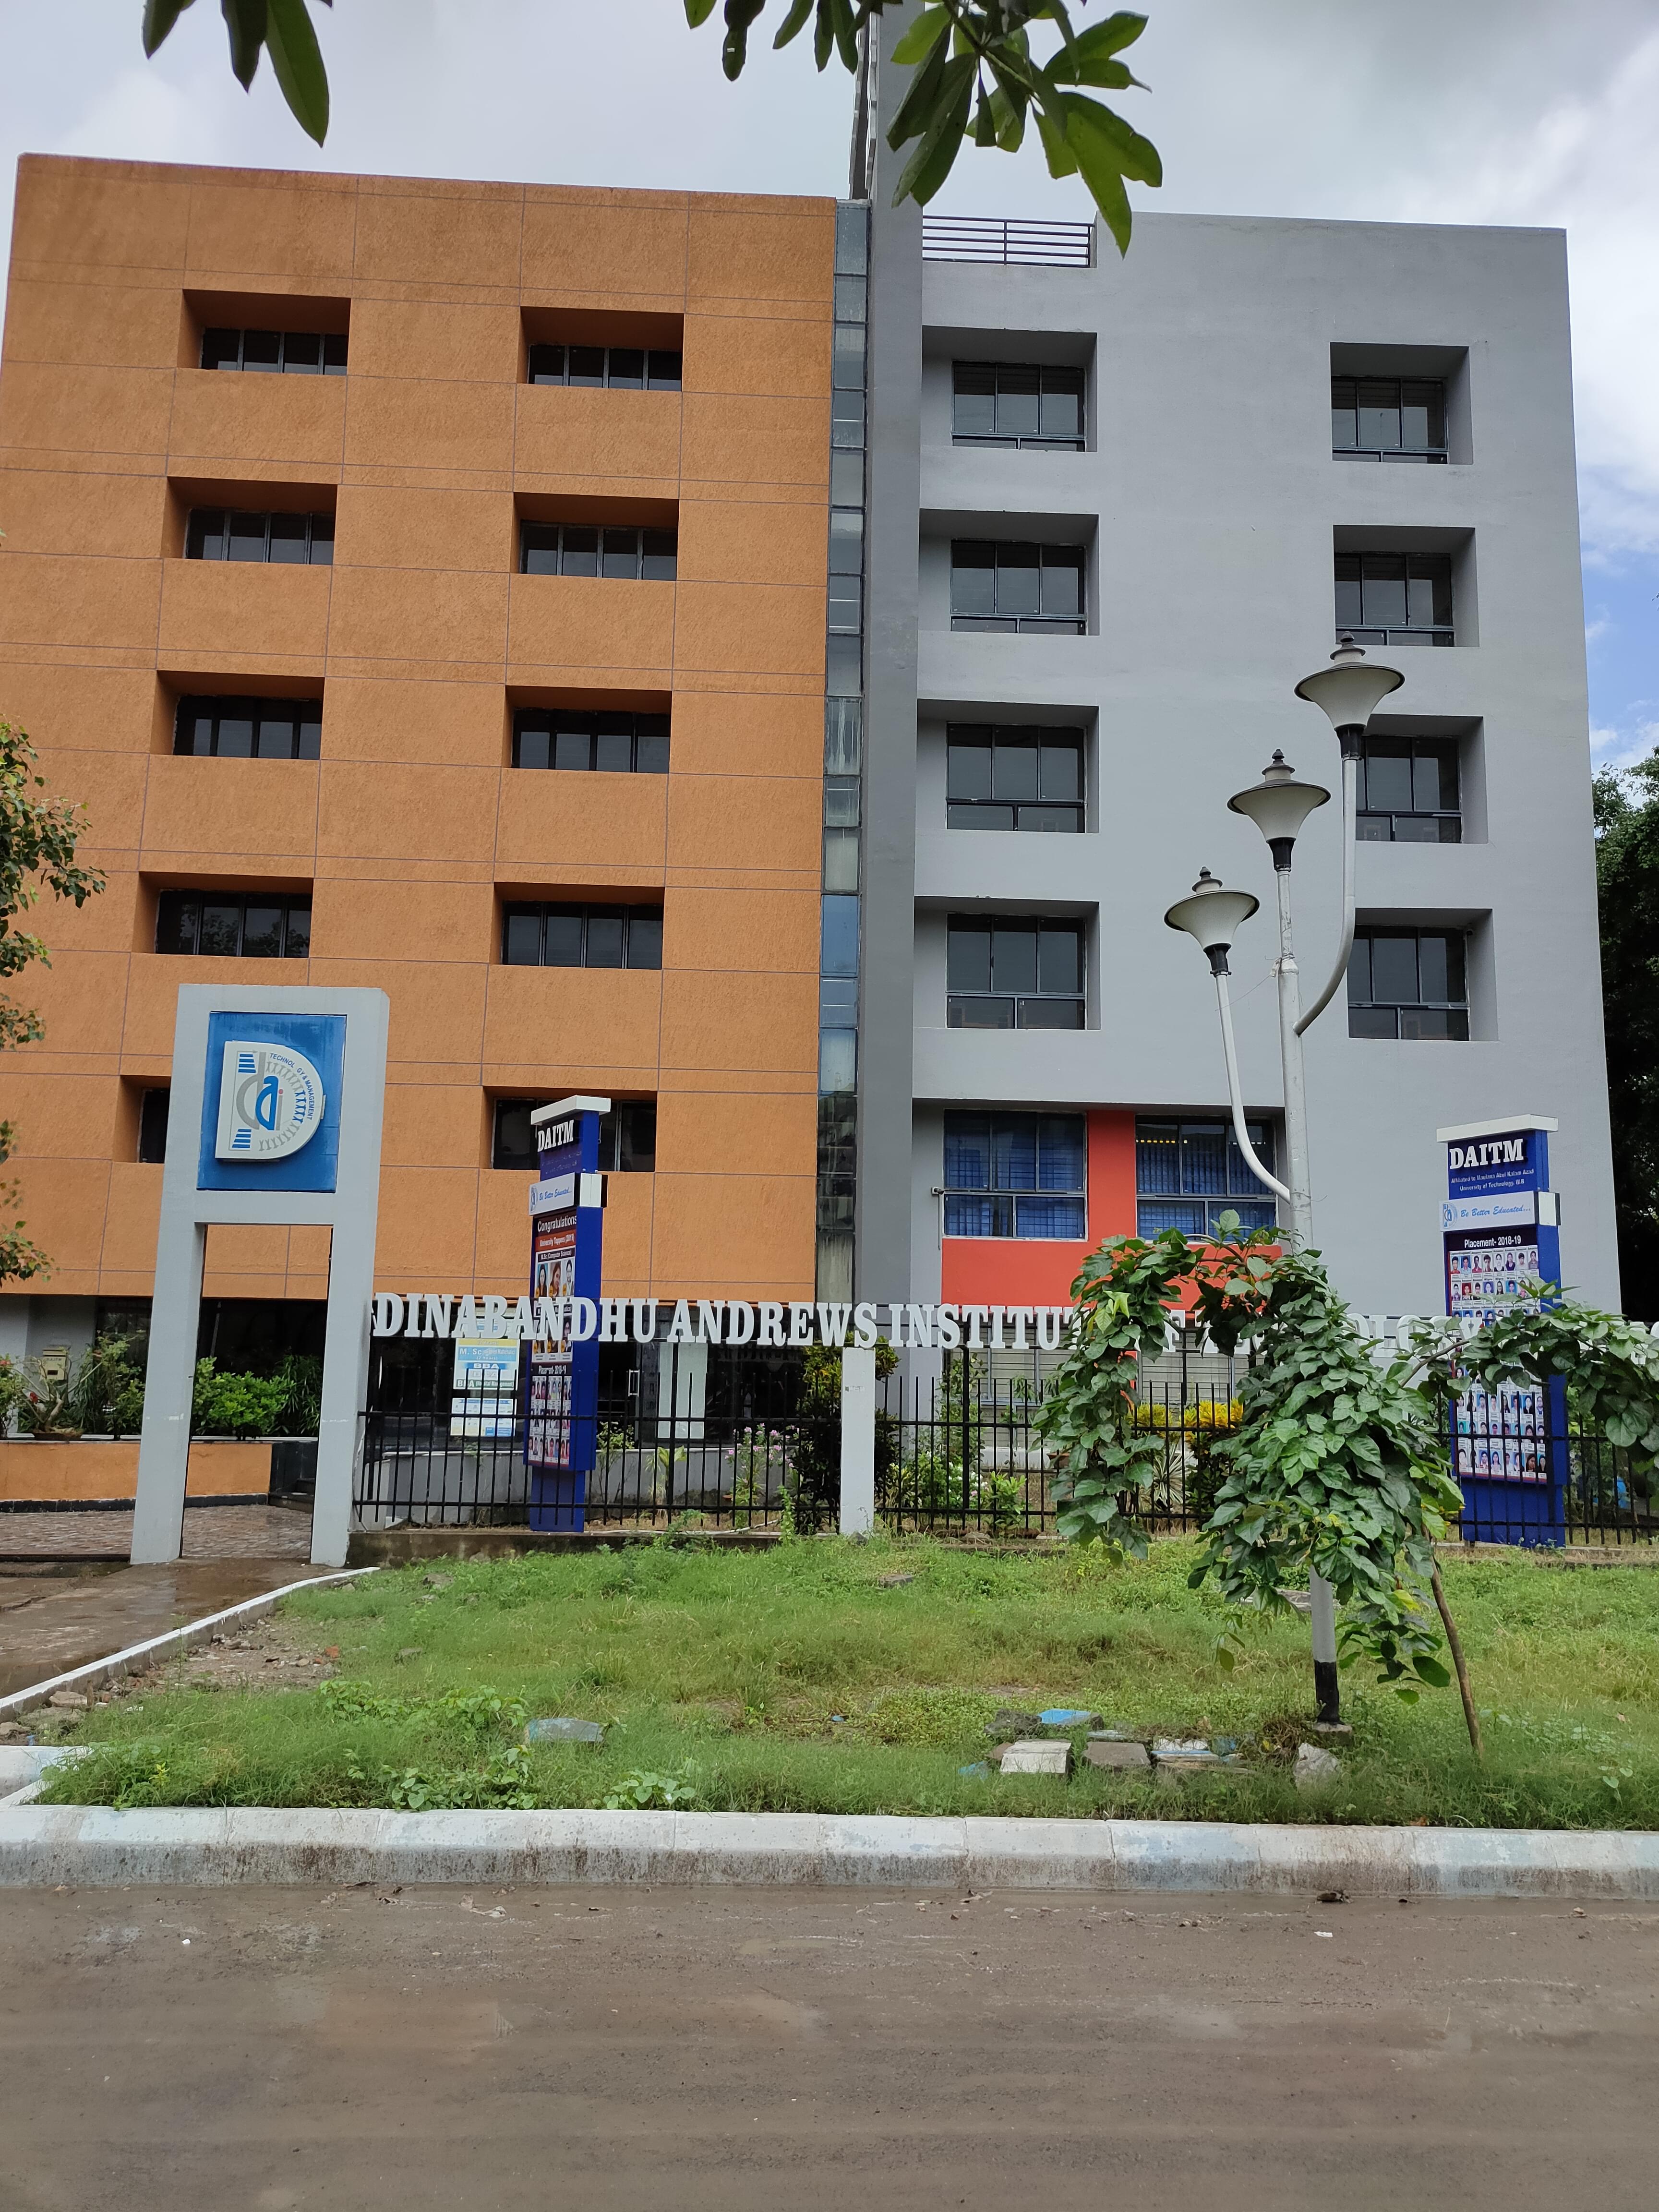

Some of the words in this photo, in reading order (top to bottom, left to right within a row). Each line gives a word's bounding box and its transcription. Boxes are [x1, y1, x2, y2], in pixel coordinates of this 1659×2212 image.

[305, 1080, 315, 1120] MANAGEMENT
[538, 1119, 574, 1152] DAITM
[1449, 1139, 1524, 1169] DAITM
[1460, 1183, 1481, 1191] University
[538, 1215, 577, 1233] Congratulations
[1461, 1209, 1469, 1217] Be
[1472, 1208, 1490, 1216] Better
[1498, 1235, 1521, 1246] 2018-19
[373, 1292, 659, 1342] DINABANDHU
[667, 1299, 877, 1348] ANDREWS
